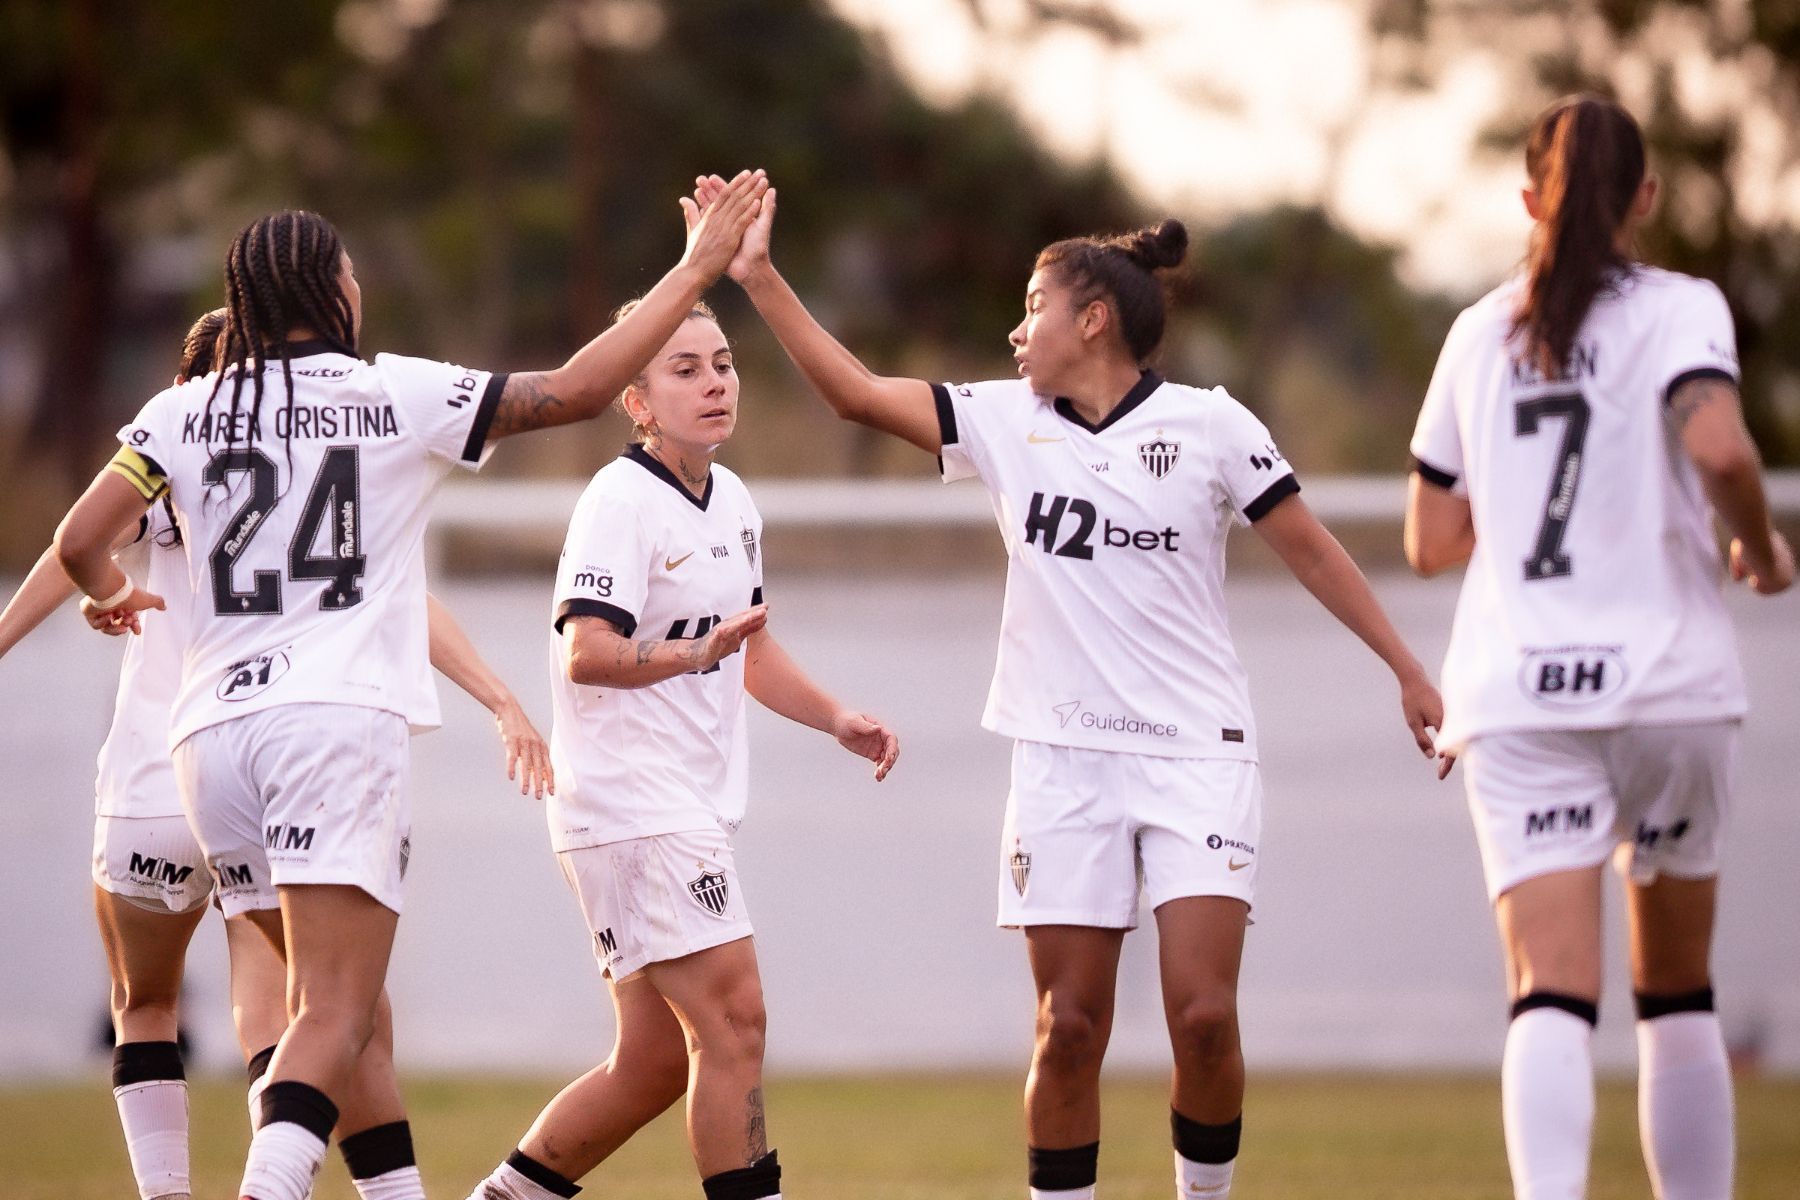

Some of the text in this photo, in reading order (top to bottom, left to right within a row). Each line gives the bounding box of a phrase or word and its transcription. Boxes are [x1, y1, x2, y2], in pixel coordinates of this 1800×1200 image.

[182, 405, 398, 443] KAREN CRISTINA
[1514, 392, 1590, 581] 7
[202, 444, 367, 616] 24
[710, 545, 730, 559] VIVA
[1538, 660, 1605, 692] BH
[1080, 711, 1178, 737] Guidance
[694, 876, 723, 891] CAM
